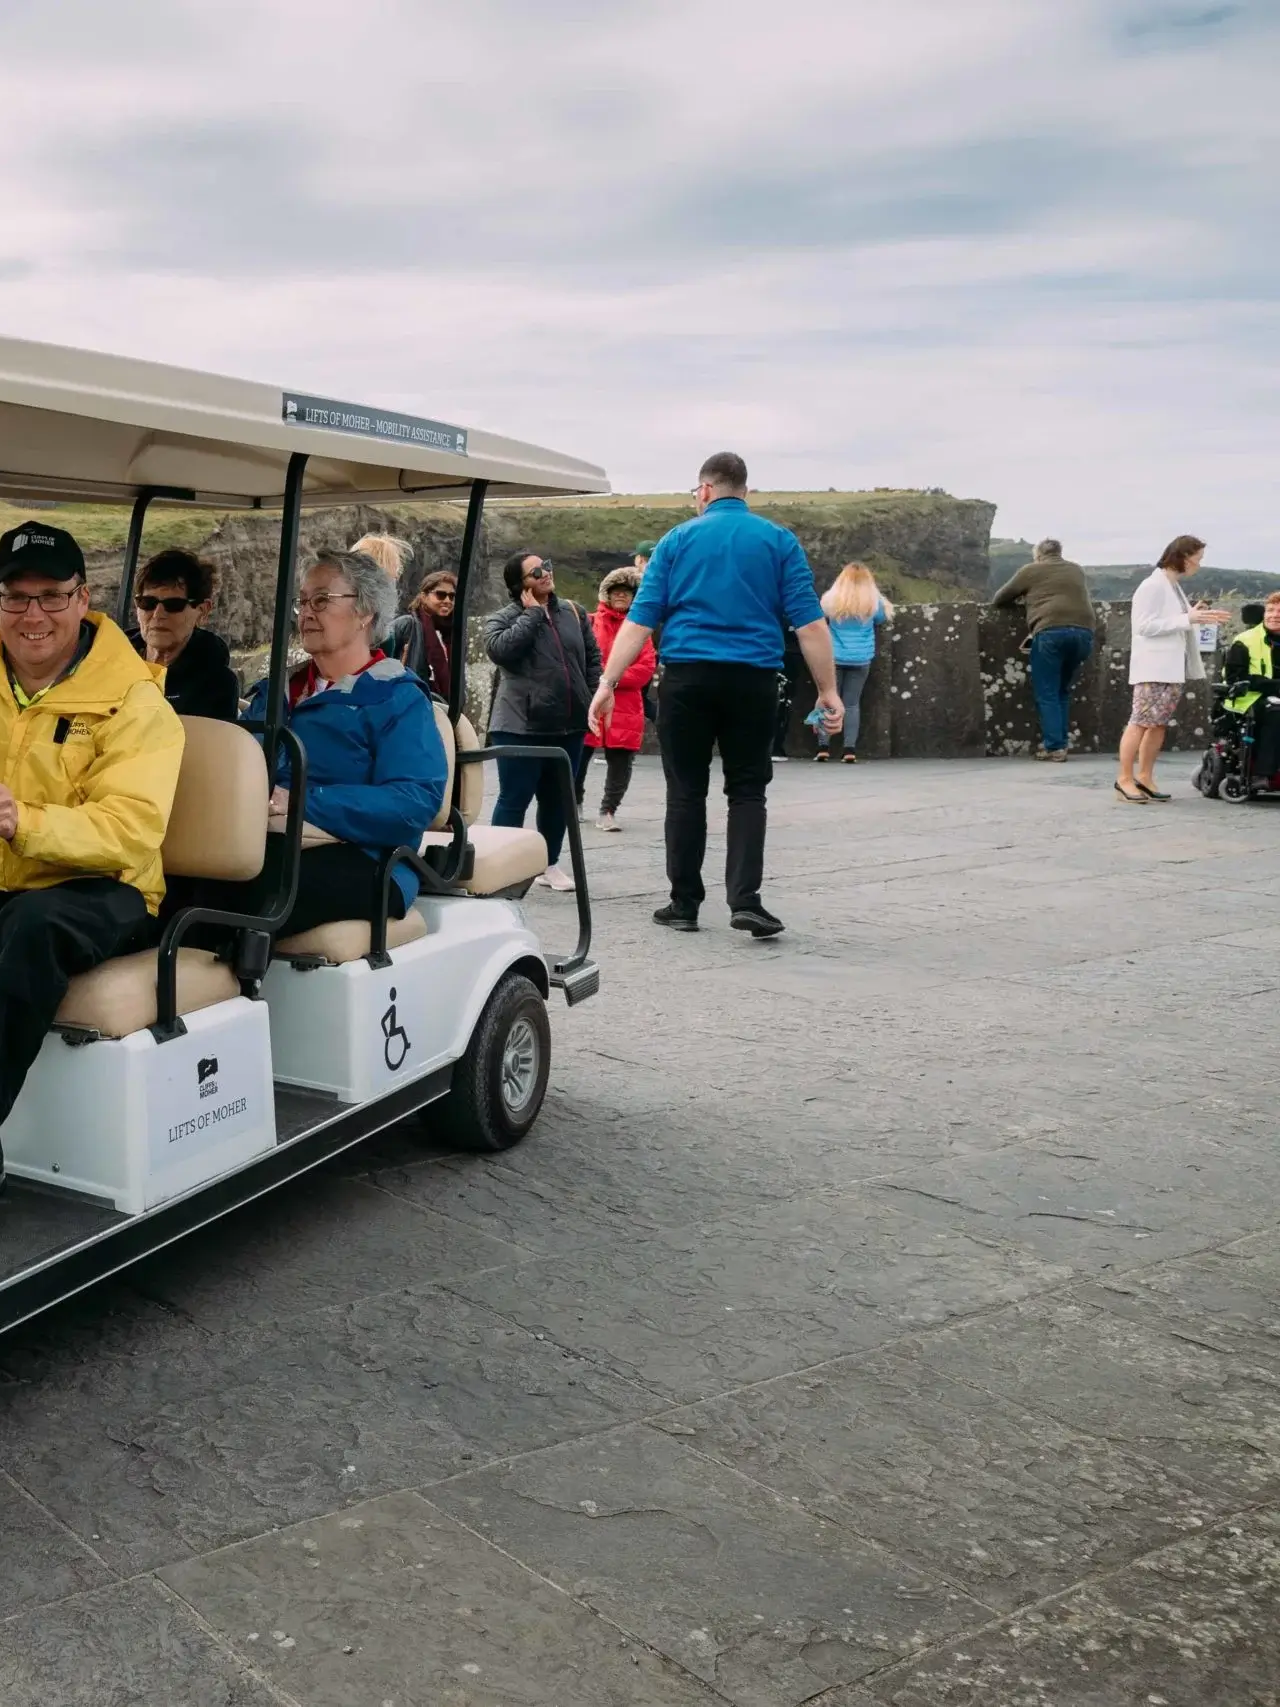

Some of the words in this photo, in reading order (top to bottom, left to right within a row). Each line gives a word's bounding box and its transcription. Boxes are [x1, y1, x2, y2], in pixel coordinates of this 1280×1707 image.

[305, 408, 329, 424] LIFTS
[329, 411, 341, 426] OF
[341, 414, 371, 431] MOHER
[376, 420, 412, 438] MOBILITY
[411, 427, 452, 447] ASSISTANCE
[168, 1119, 196, 1143] LIFTS
[197, 1112, 211, 1130] OF
[212, 1098, 248, 1122] MOHER
